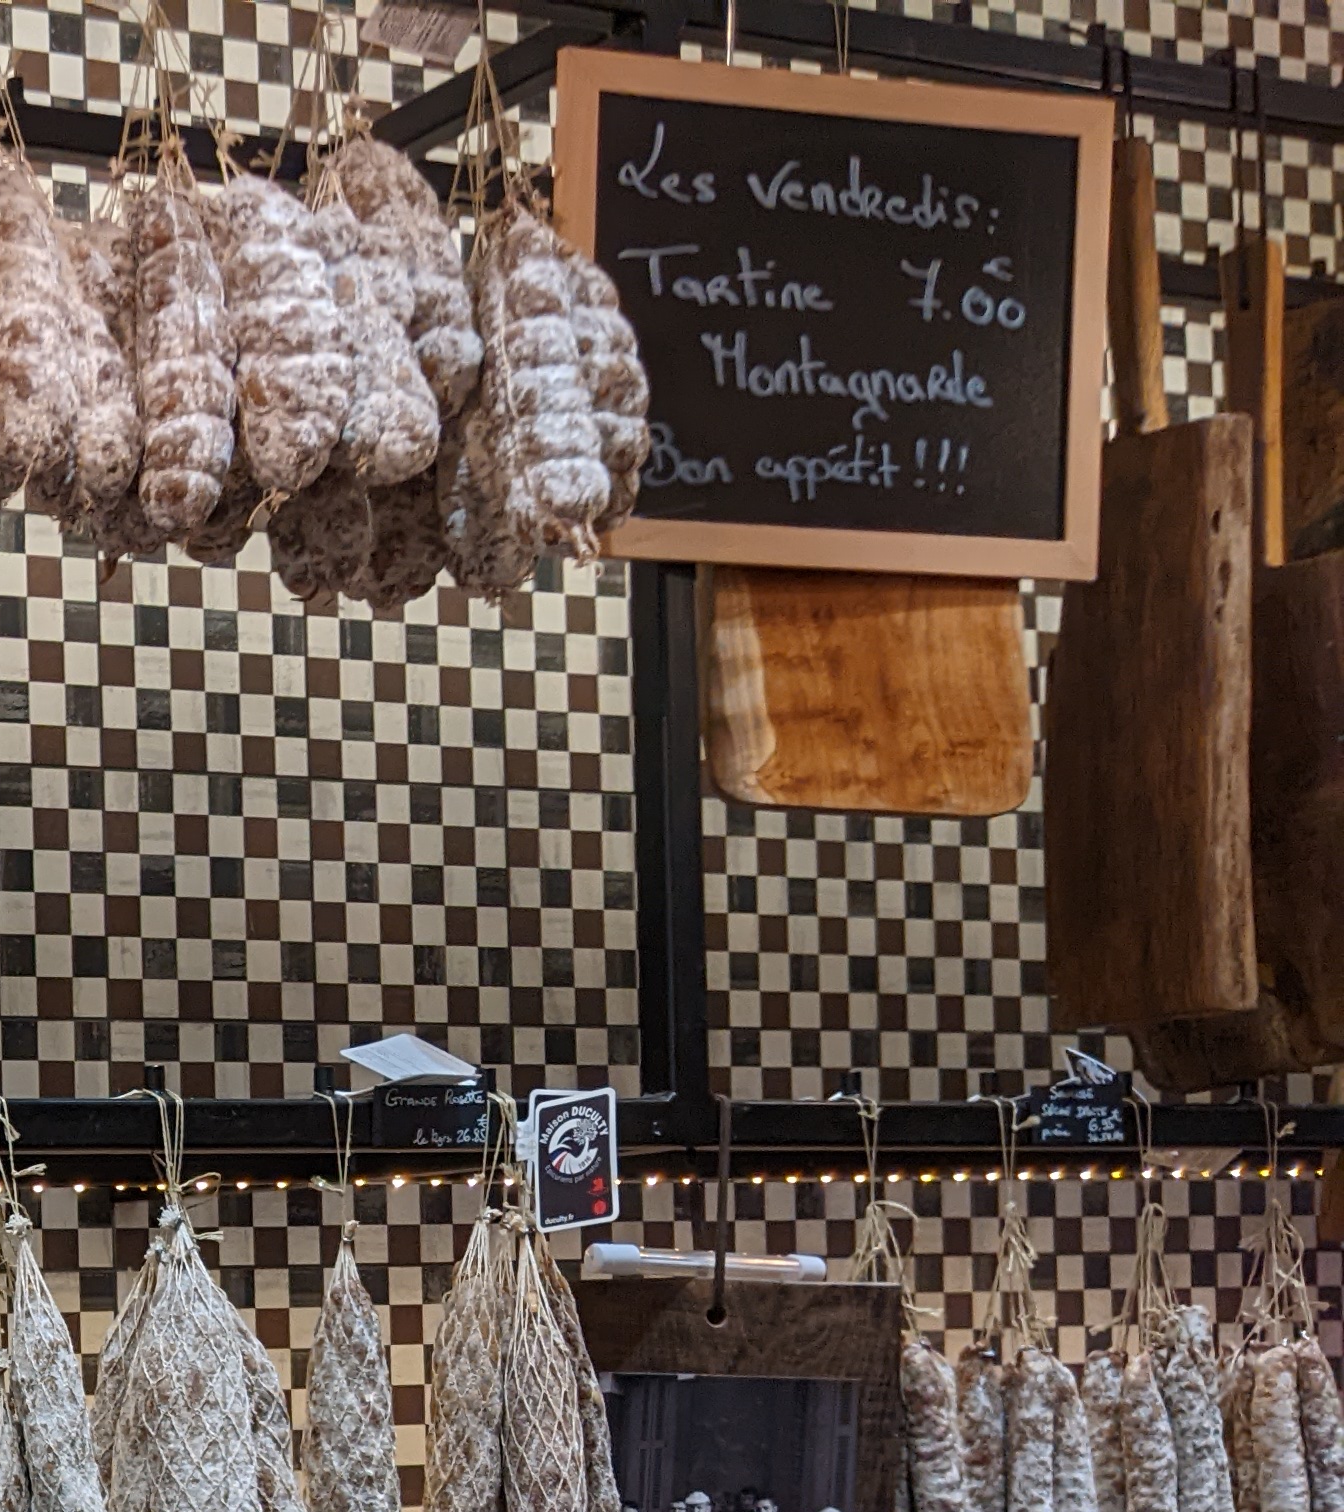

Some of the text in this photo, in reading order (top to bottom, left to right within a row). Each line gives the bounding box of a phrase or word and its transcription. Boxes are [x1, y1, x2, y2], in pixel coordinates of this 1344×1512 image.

[618, 122, 715, 203] Les
[618, 244, 834, 311] Tartine
[700, 332, 994, 432] Montagnarde
[643, 421, 733, 486] Bon
[539, 1106, 609, 1145] Maison DUCULTY
